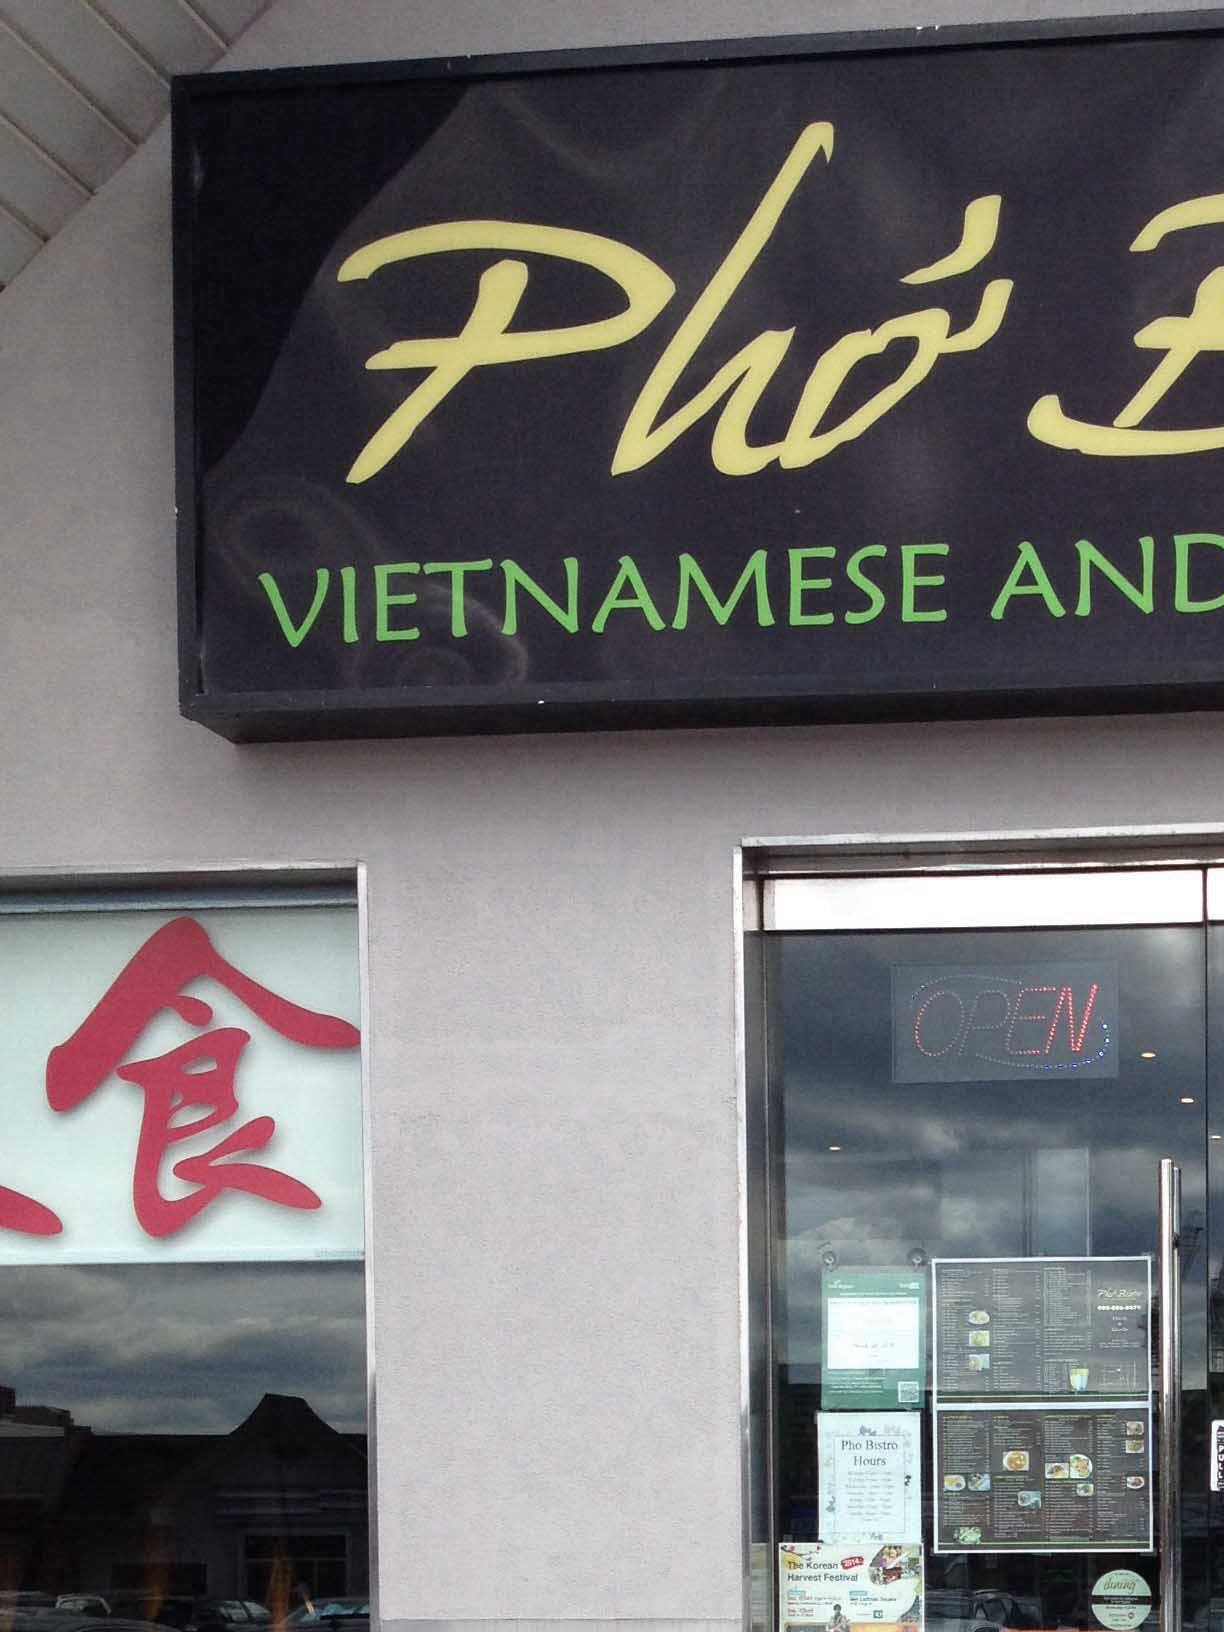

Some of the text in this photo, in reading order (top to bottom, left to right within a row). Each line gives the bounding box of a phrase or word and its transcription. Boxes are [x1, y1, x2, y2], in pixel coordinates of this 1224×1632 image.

[260, 545, 950, 646] VIETNAMESE
[914, 983, 1099, 1057] OPEN
[0, 917, 361, 1238] 食
[841, 1440, 898, 1451] Pho Bistro
[853, 1456, 887, 1466] Hours
[787, 1561, 804, 1570] The
[806, 1560, 839, 1570] Korean
[787, 1572, 859, 1582] Harvest Festival
